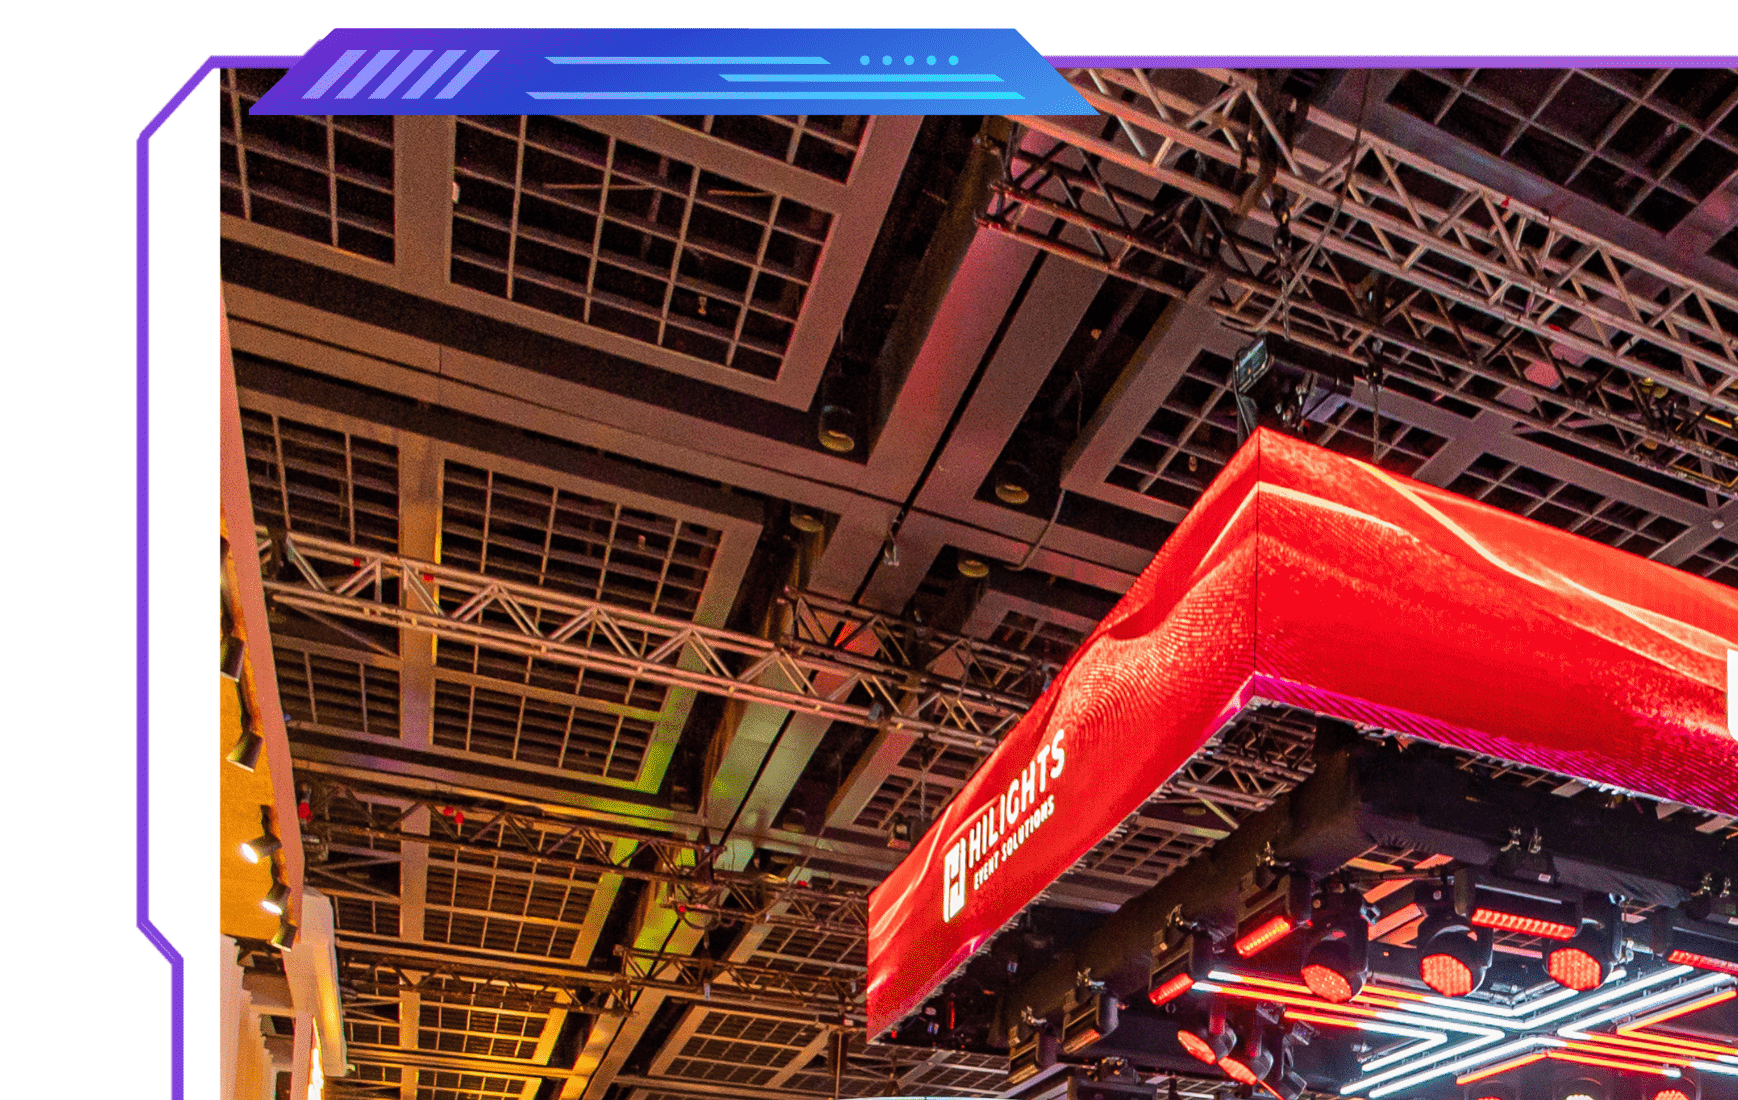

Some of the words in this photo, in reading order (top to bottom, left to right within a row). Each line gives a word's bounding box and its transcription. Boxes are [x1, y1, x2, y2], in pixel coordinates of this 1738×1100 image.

[969, 729, 1066, 869] HILIGHTS
[974, 850, 1000, 890] EVENT
[1002, 795, 1055, 862] SOLUTIONS
